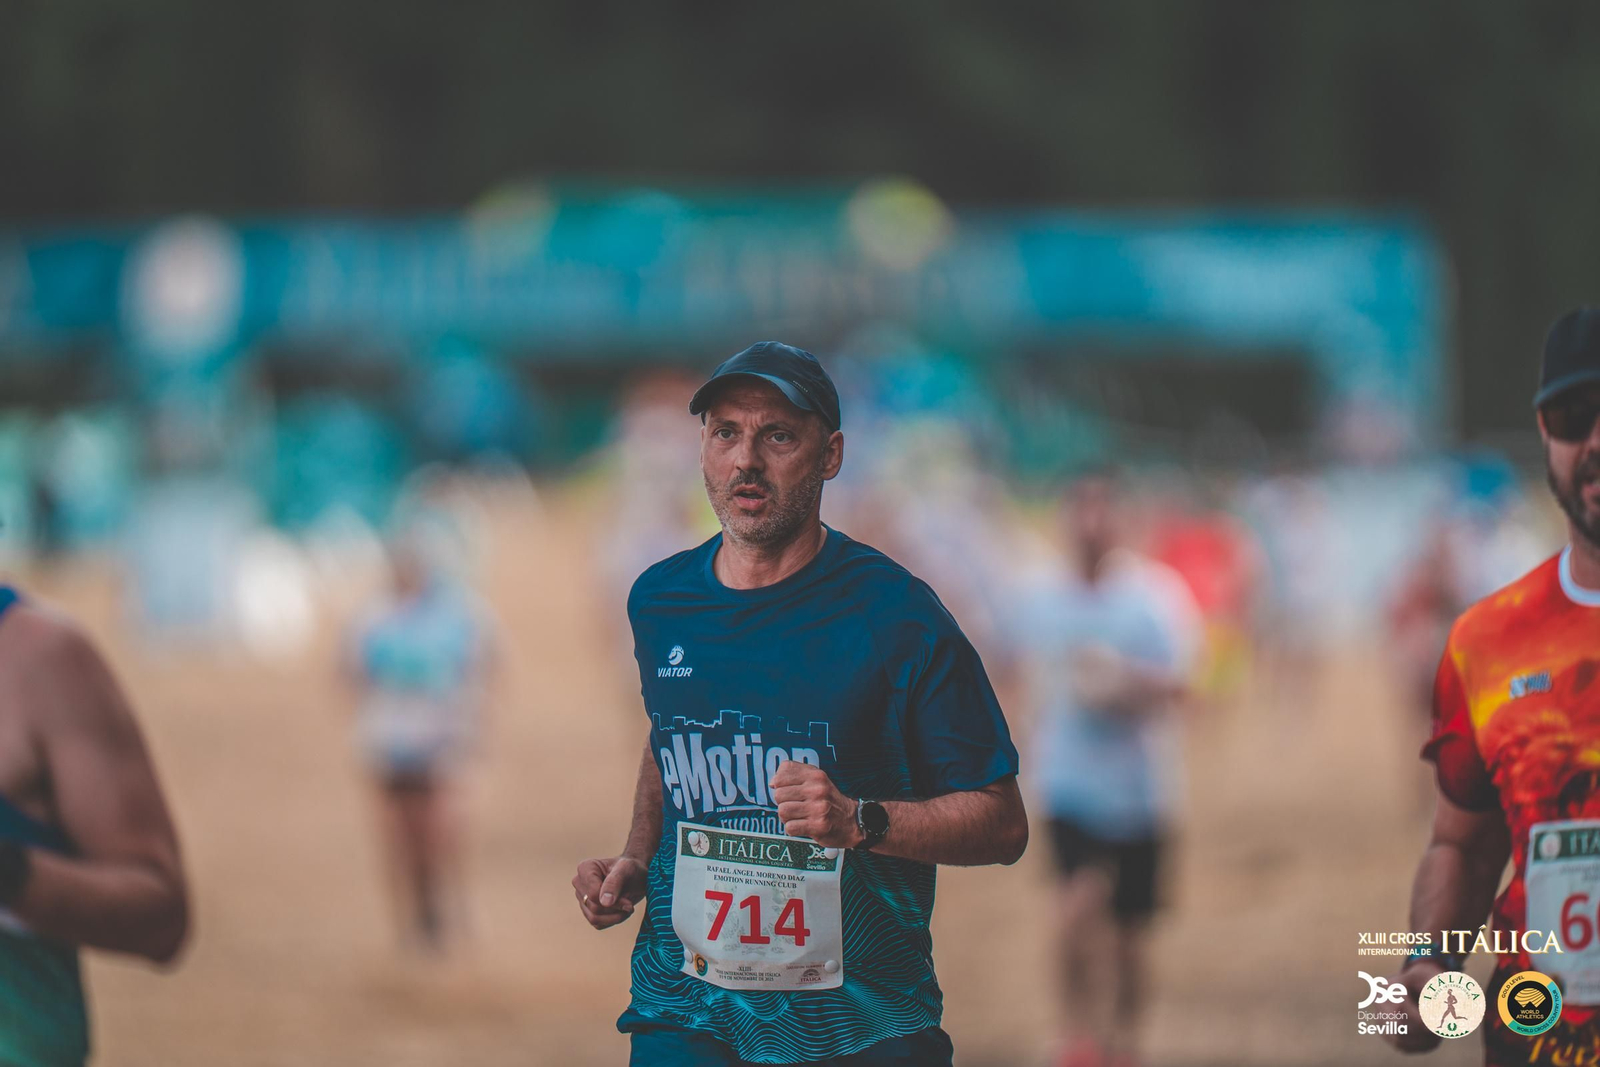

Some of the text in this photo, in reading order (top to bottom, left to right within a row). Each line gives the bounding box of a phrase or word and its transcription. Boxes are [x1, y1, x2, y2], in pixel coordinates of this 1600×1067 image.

[657, 667, 693, 678] VIATOR
[718, 837, 794, 863] ITÁLICA
[706, 865, 732, 874] RAFAEL
[732, 868, 755, 877] ANGEL
[756, 871, 787, 880] MORENO
[713, 874, 797, 889] EMOTION RUNNING CLUB
[705, 890, 811, 946] 714
[1560, 893, 1600, 952] 6
